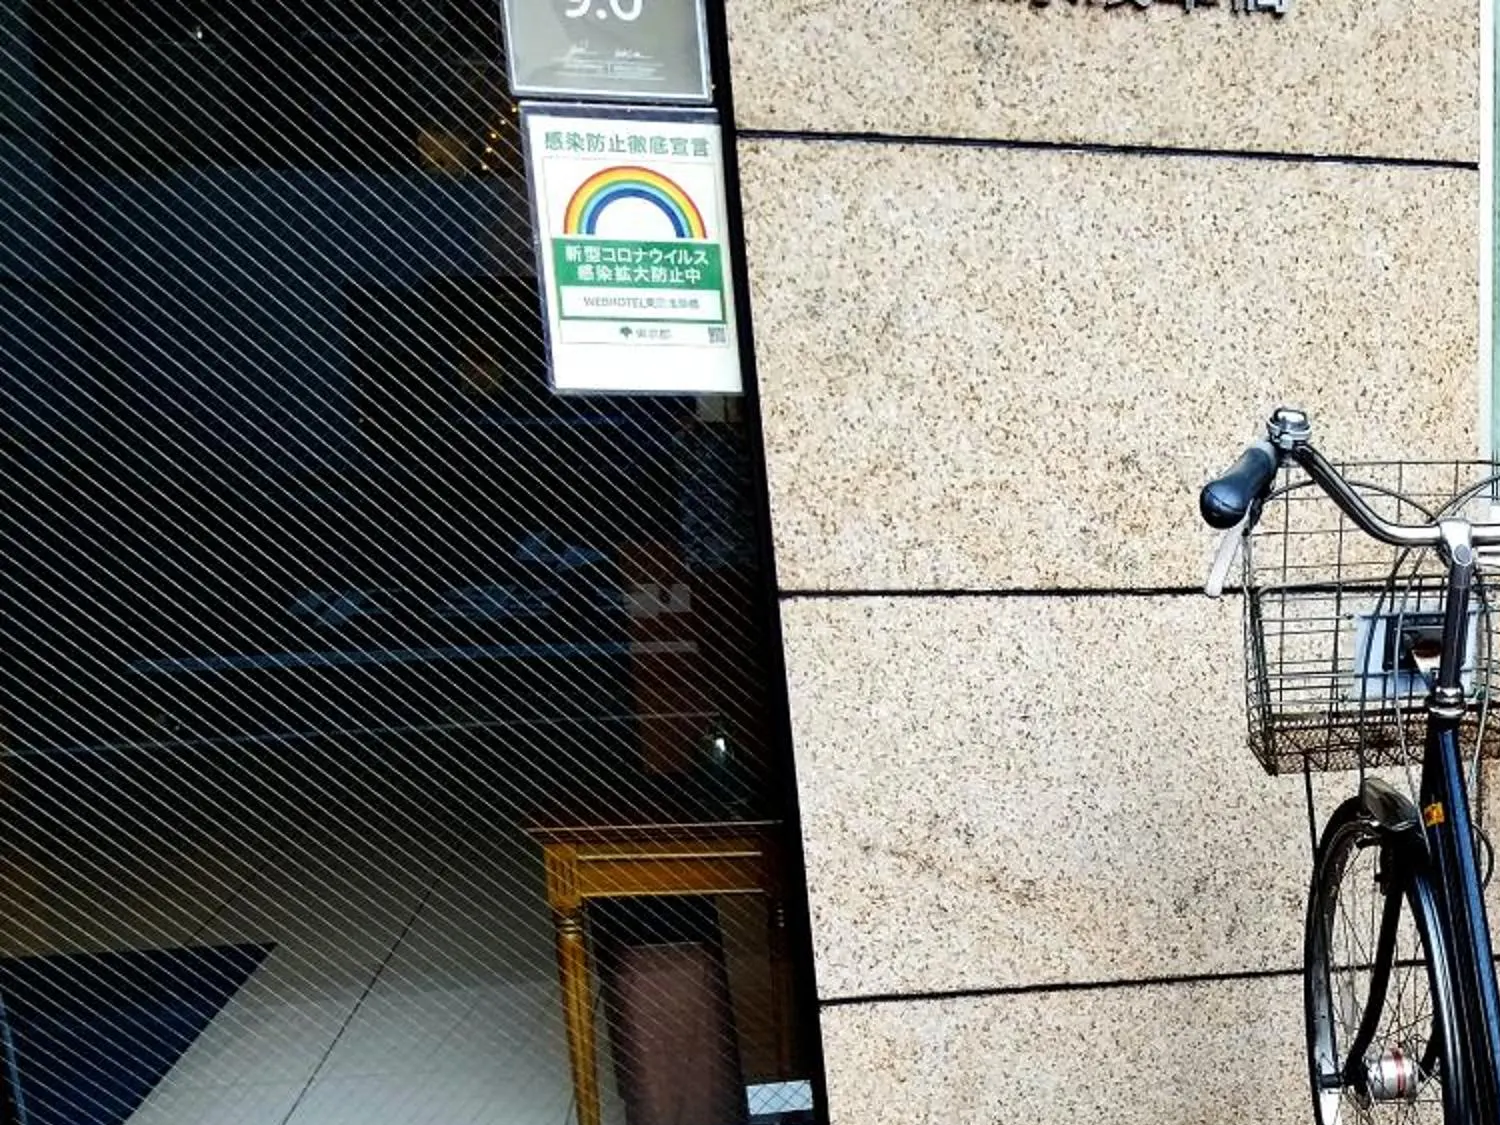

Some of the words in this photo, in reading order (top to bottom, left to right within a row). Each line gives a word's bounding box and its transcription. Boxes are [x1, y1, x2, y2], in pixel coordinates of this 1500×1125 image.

[544, 130, 711, 158] 感染防止徹底宣言
[564, 244, 709, 266] 新型コロナウイルス
[576, 263, 702, 285] 感染拡大防止中
